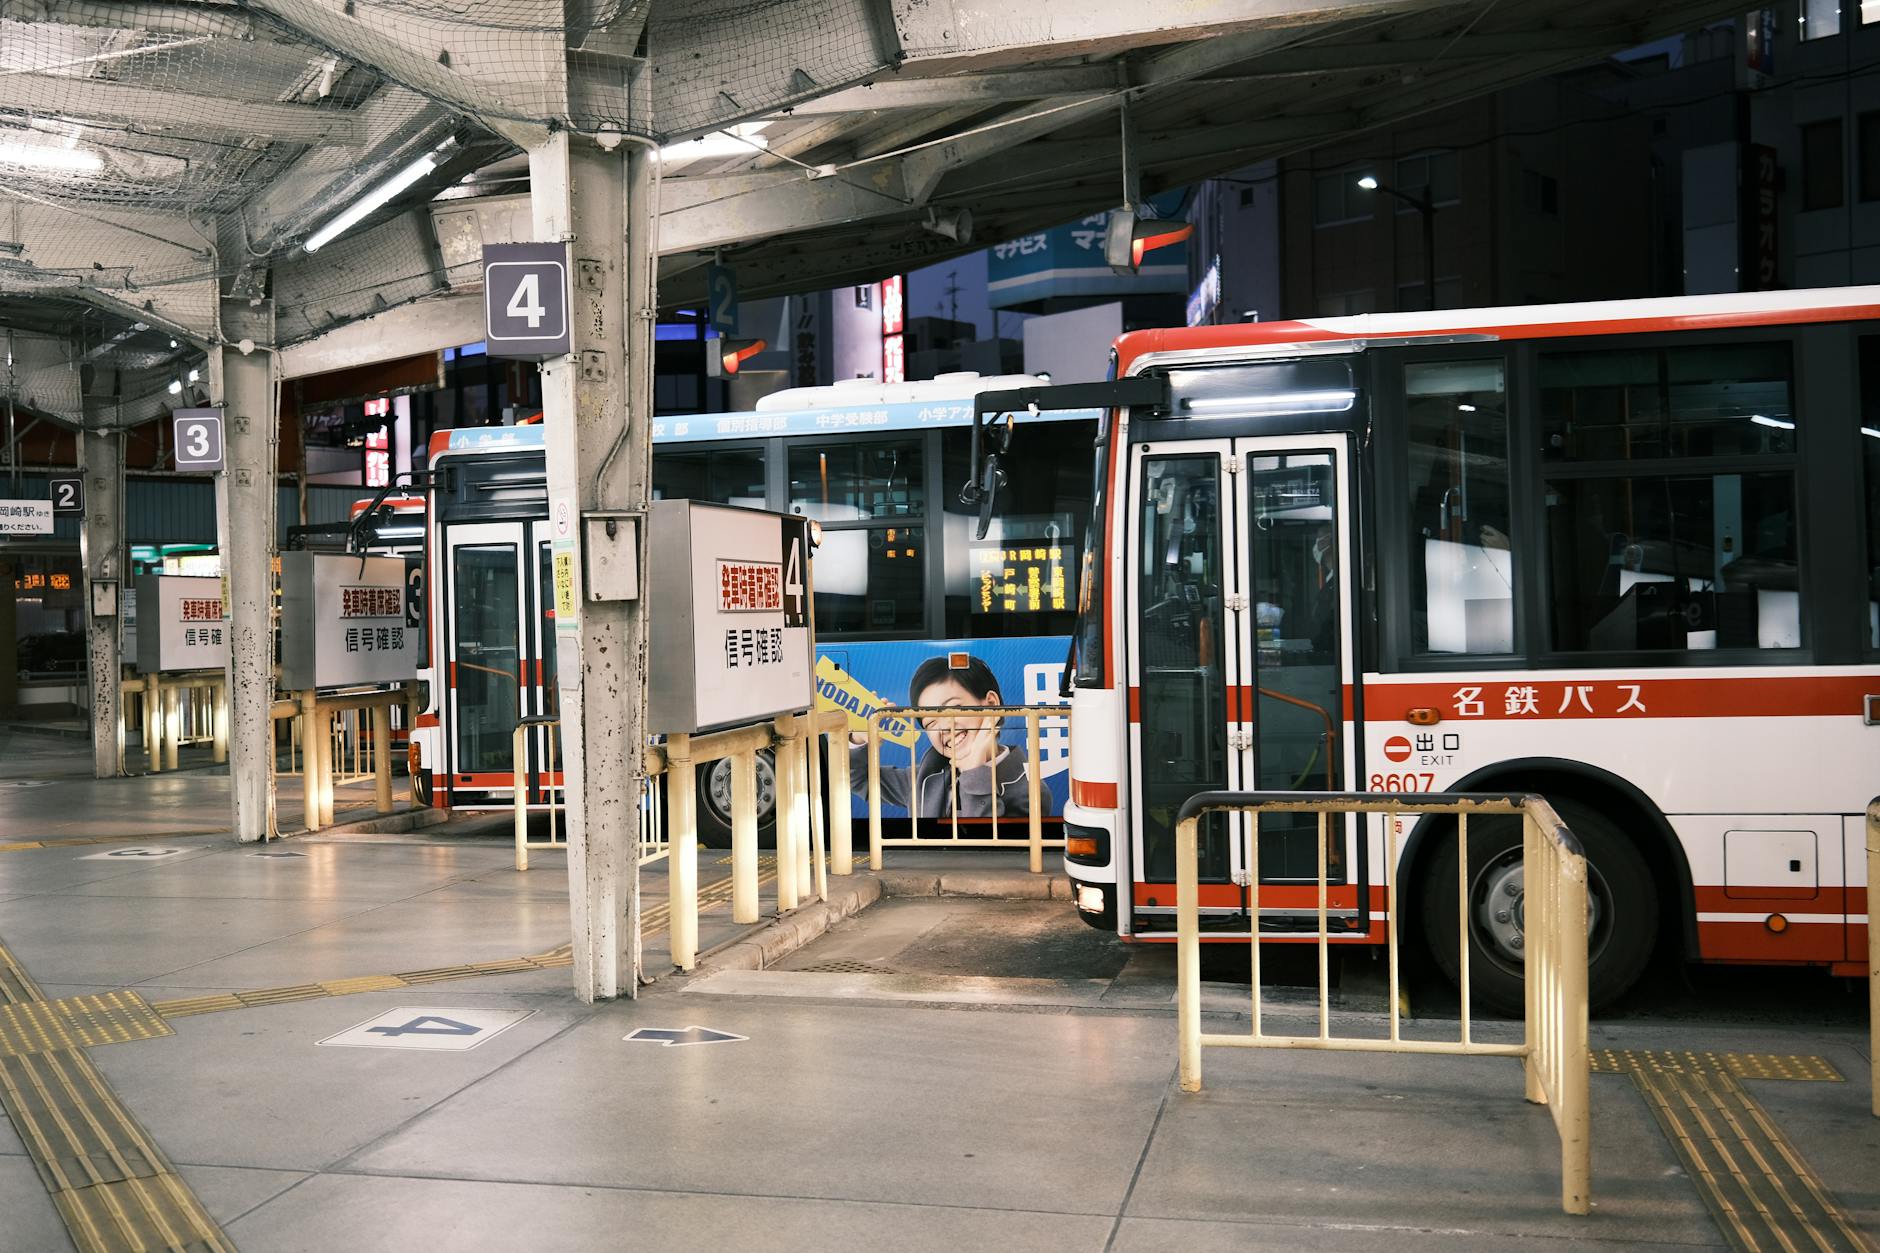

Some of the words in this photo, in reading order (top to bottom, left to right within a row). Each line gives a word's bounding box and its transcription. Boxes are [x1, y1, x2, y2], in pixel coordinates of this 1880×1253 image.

[1759, 154, 1776, 285] カラオケ
[993, 232, 1048, 260] マナビス
[506, 273, 546, 328] 4
[715, 275, 733, 325] 2
[186, 424, 211, 458] 3
[58, 483, 75, 507] 2
[785, 537, 804, 614] 4
[345, 627, 405, 653] 信号確認
[725, 627, 784, 669] 信号確認
[1452, 684, 1647, 716] 名鉄バス
[1416, 733, 1460, 752] 出口
[1421, 754, 1455, 766] EXIT
[1370, 773, 1436, 793] 8607
[363, 1014, 484, 1037] 4
